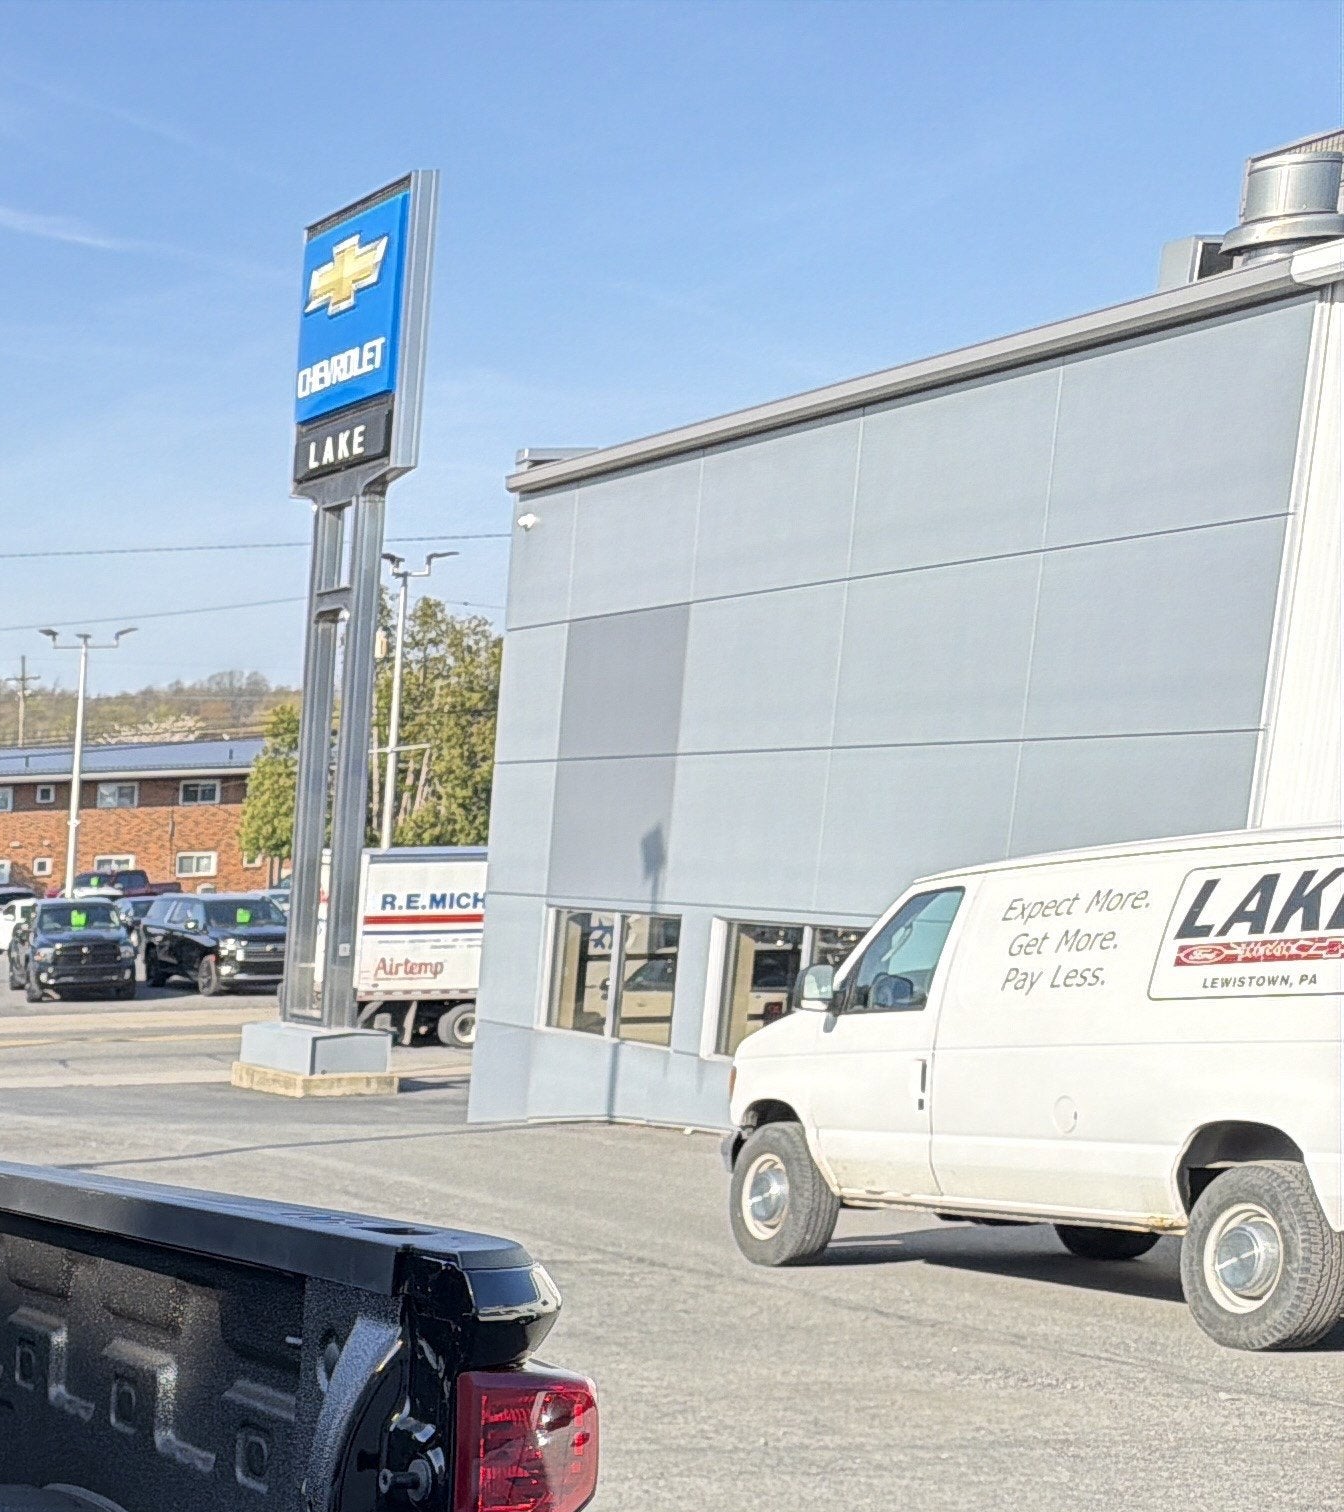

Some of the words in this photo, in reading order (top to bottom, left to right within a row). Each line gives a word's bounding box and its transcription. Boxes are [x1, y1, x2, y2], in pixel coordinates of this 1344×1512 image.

[296, 336, 386, 399] CHEVROLET
[307, 424, 366, 471] LAKE
[1001, 893, 1080, 925] Expect
[1084, 888, 1150, 914] More.
[1008, 932, 1050, 957] Get
[1054, 928, 1118, 953] More.
[374, 957, 445, 979] Airtemp
[1001, 967, 1043, 996] Pay
[1049, 965, 1105, 988] Less.
[1201, 975, 1294, 989] LEWISTOWN,
[1298, 973, 1318, 986] PA
